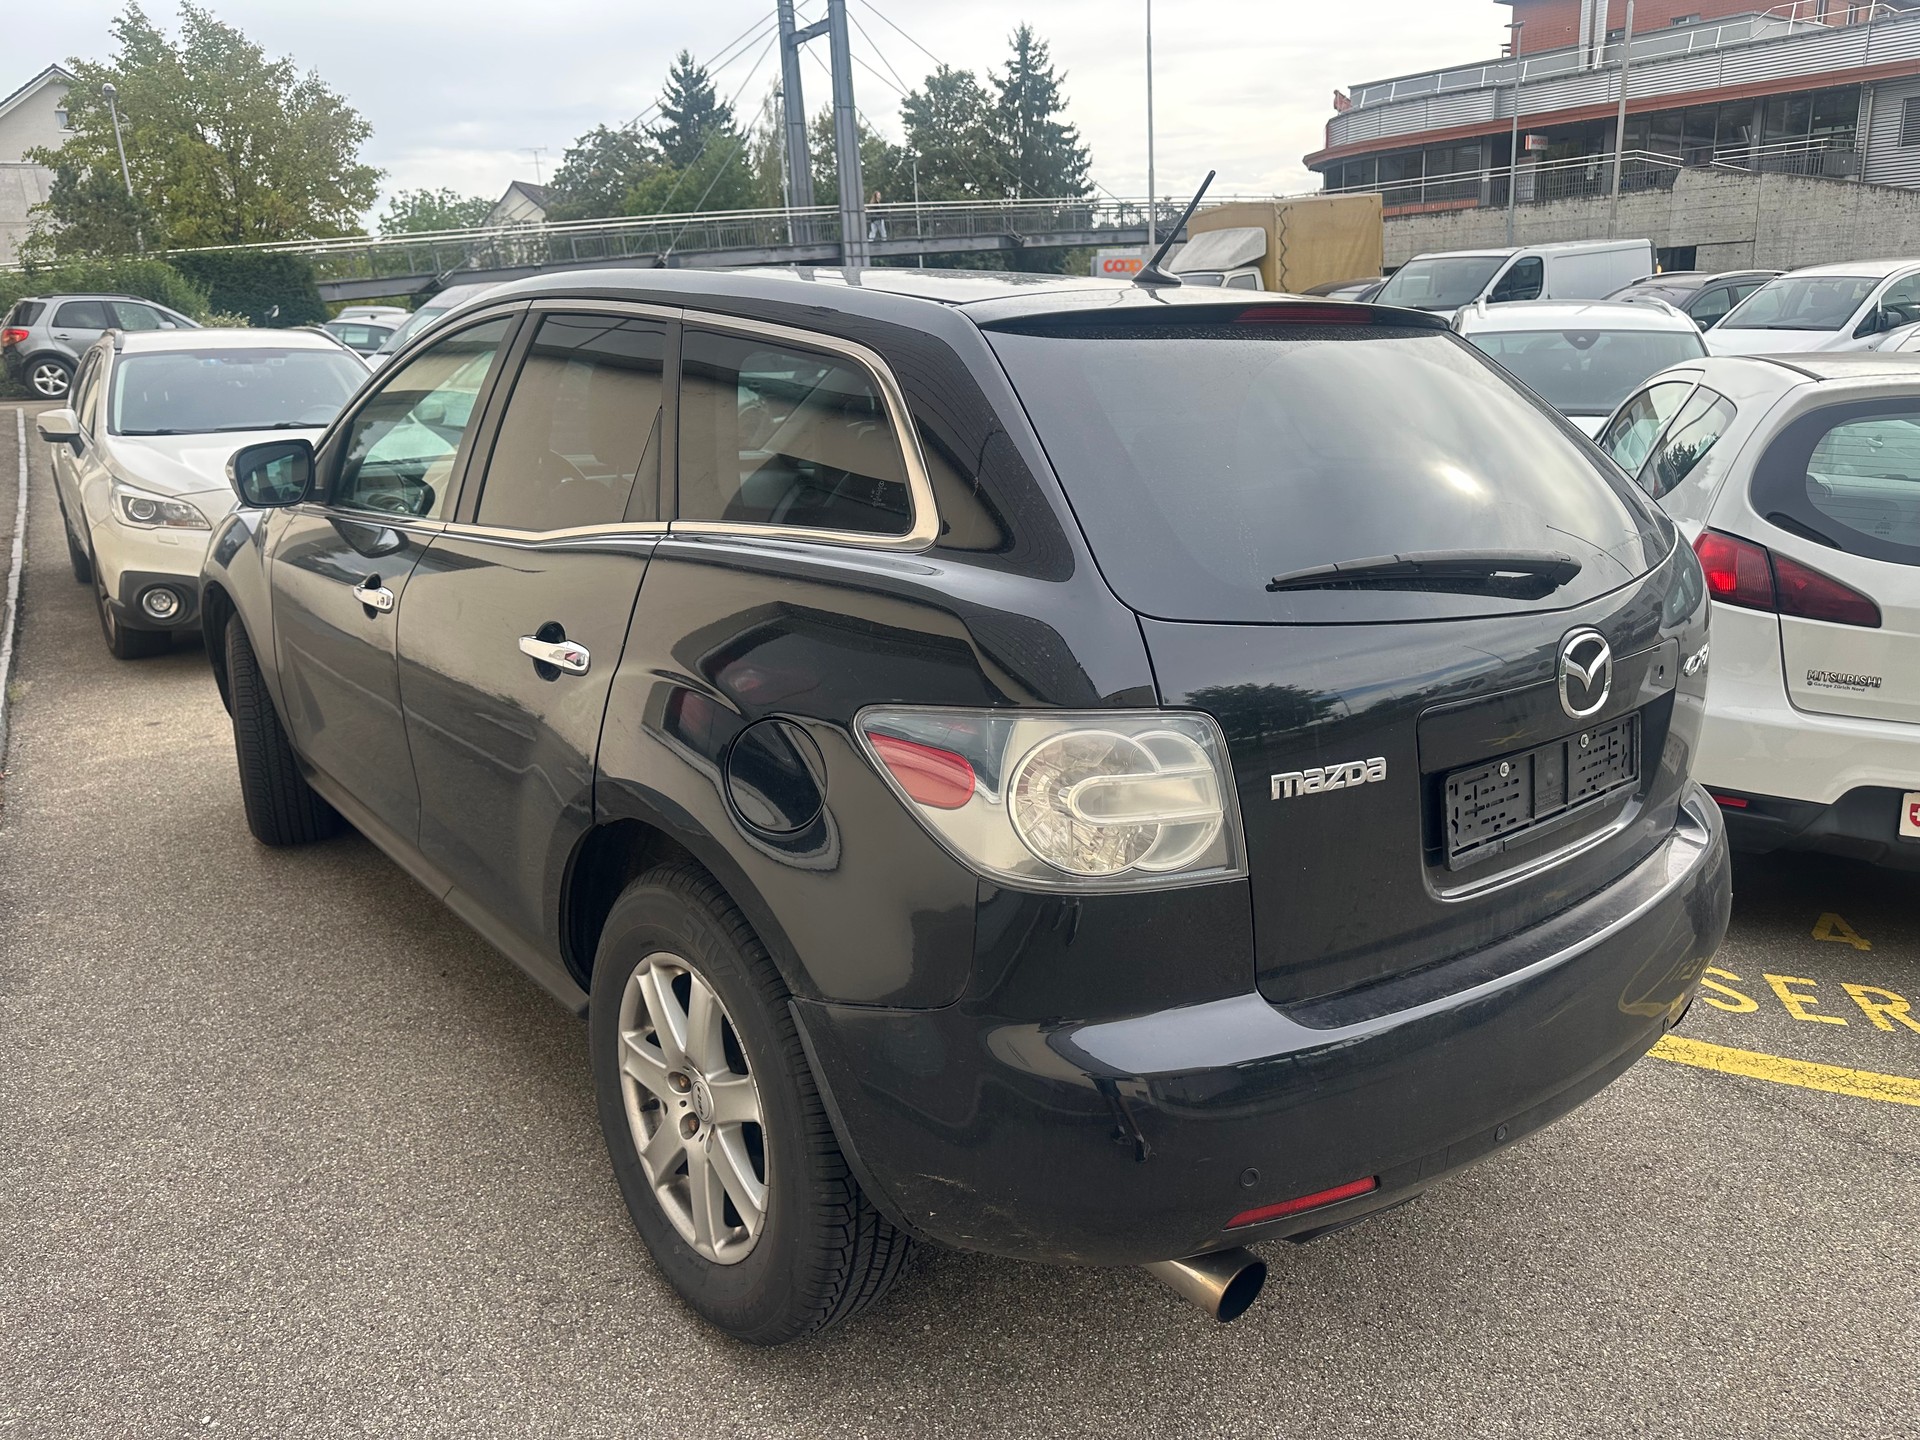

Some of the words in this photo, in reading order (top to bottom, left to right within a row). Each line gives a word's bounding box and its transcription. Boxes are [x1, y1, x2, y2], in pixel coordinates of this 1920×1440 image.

[1104, 259, 1143, 275] coop
[1806, 669, 1882, 688] MITSUBISHI
[1813, 681, 1833, 689] Garage
